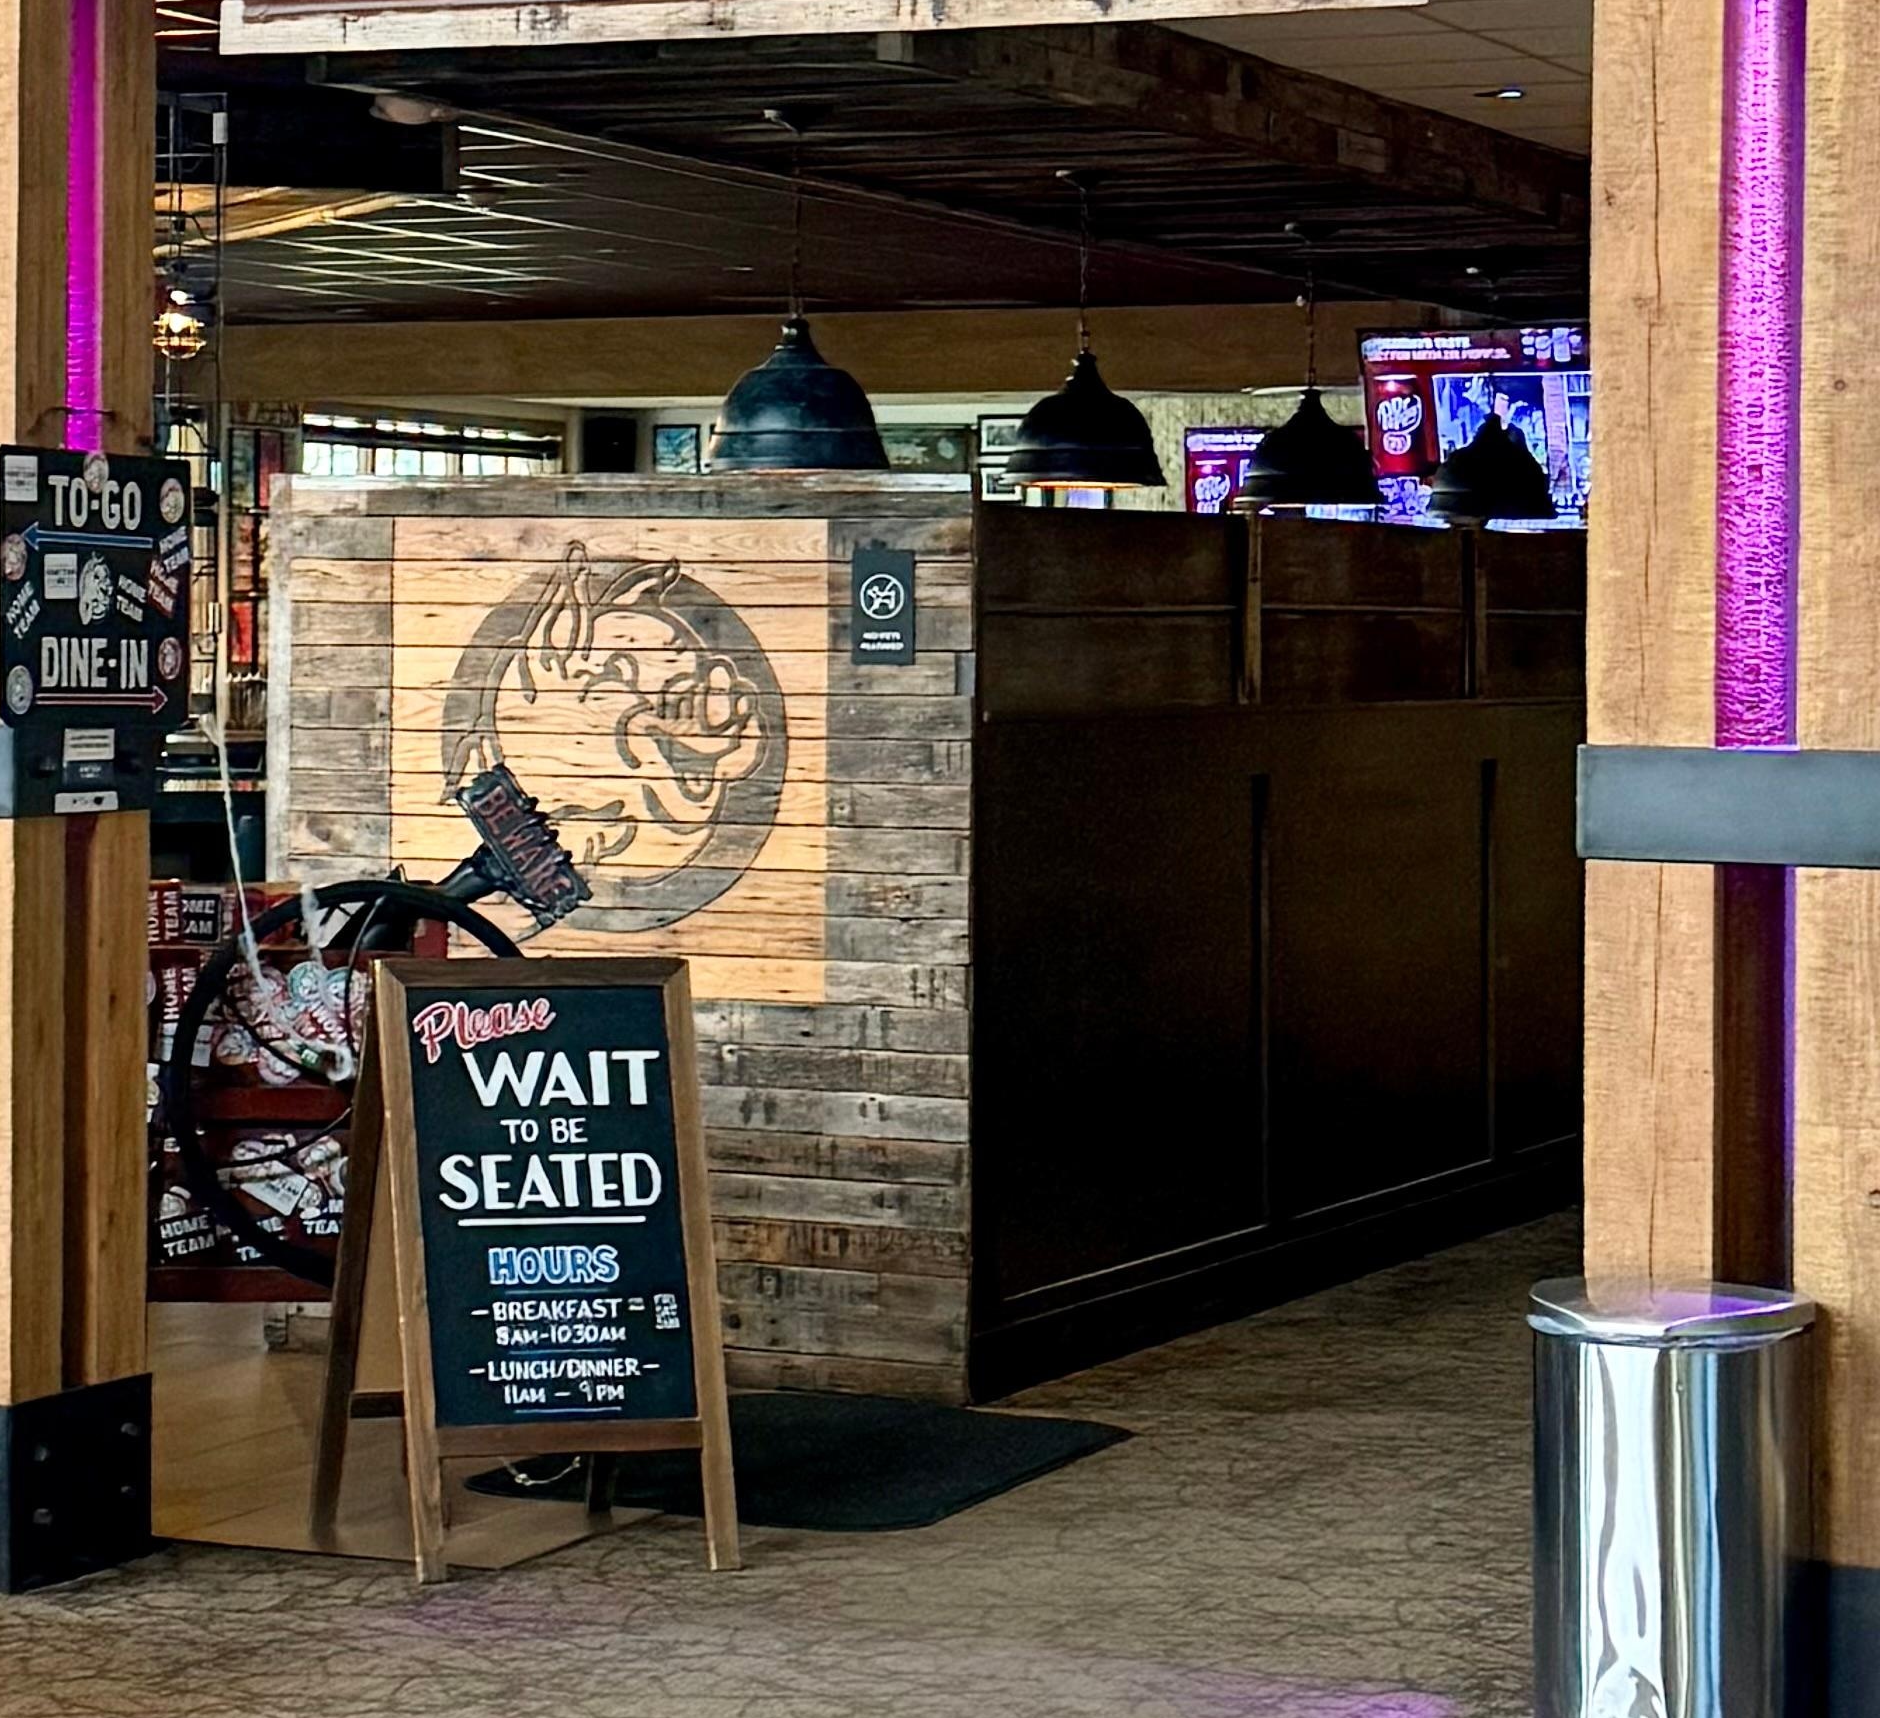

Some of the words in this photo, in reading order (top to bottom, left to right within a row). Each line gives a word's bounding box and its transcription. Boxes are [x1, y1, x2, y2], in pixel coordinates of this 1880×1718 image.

[48, 474, 142, 530] TO-GO
[40, 636, 149, 690] DINE-IN
[412, 998, 556, 1063] Please
[462, 1051, 660, 1107] WAIT
[500, 1119, 539, 1144] TO
[551, 1118, 588, 1143] BE
[439, 1153, 662, 1210] SEATED
[159, 1214, 210, 1240] HOME
[163, 1233, 216, 1258] TEAM
[488, 1245, 620, 1285] HOURS
[504, 1385, 546, 1404] 11AM
